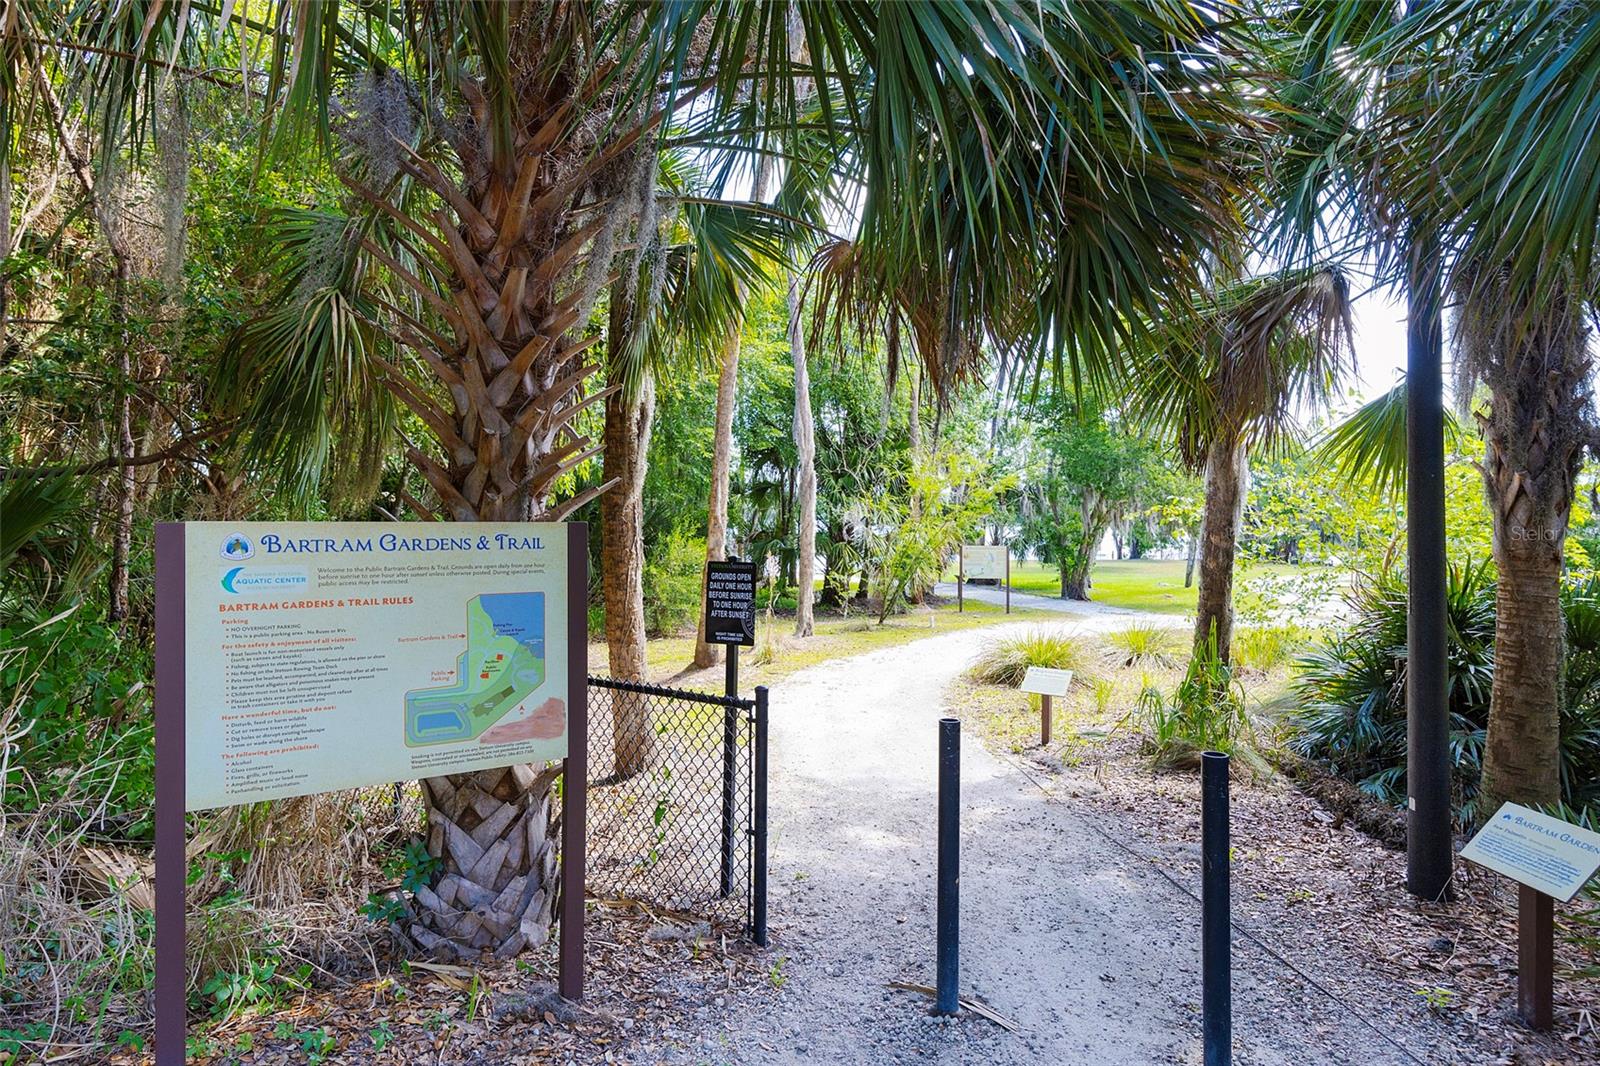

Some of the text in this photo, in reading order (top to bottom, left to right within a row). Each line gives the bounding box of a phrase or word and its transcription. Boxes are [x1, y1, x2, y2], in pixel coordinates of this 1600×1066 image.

[260, 533, 545, 553] BARTRAM GARDENS & TRAIL
[219, 602, 278, 612] BARTRAM
[282, 600, 334, 610] GARDENS
[348, 598, 379, 607] TRAIL
[383, 596, 414, 605] RULES
[282, 744, 319, 754] prohibited:
[1514, 816, 1558, 838] BARTRAM
